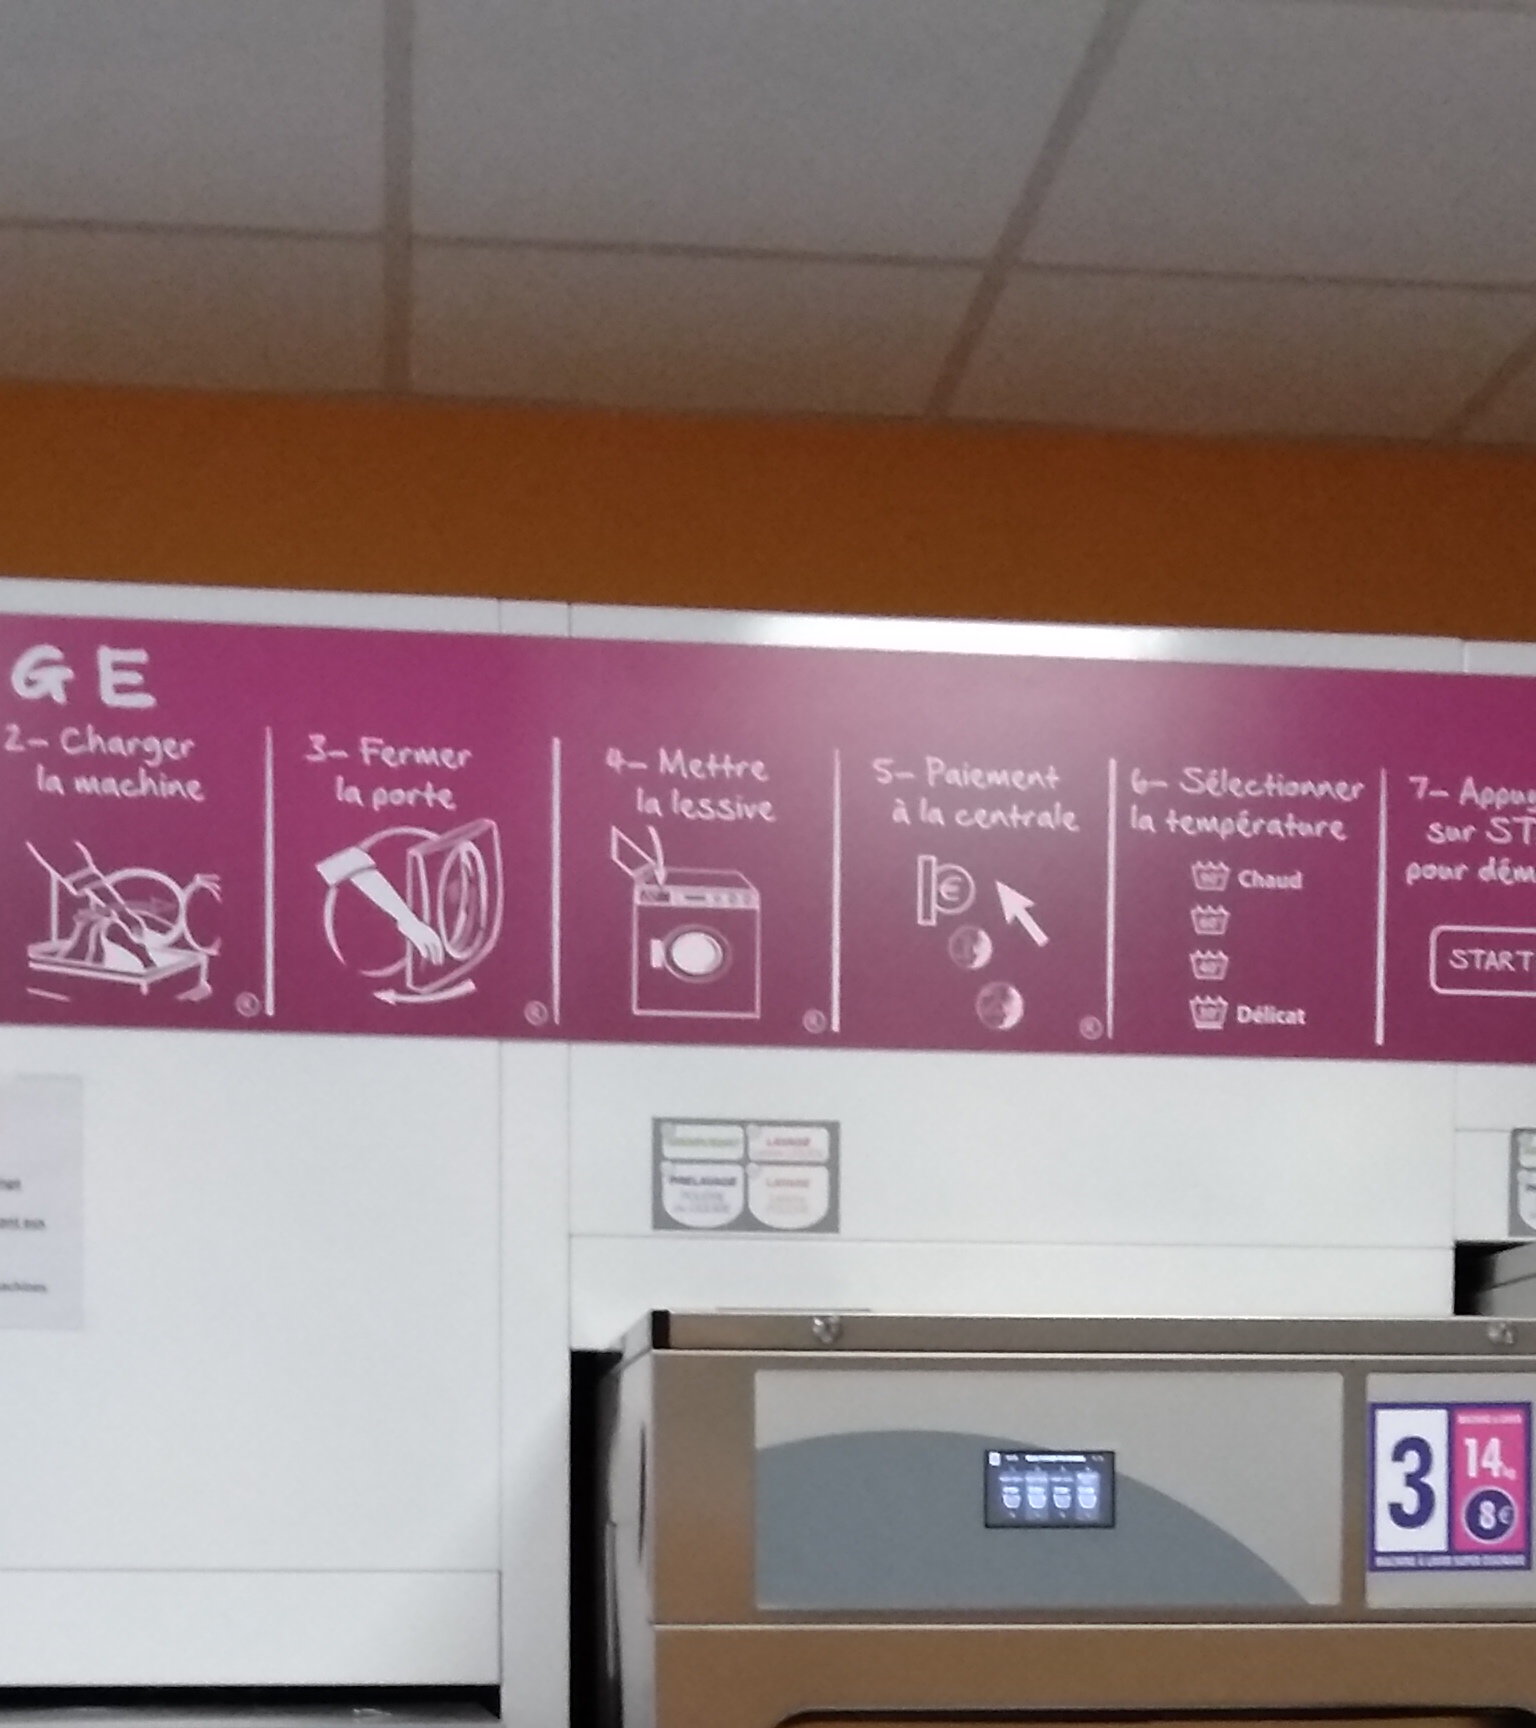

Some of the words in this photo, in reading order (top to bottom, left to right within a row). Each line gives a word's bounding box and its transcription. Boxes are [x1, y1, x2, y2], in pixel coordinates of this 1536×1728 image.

[60, 723, 195, 768] Charger
[360, 735, 473, 770] Fermer
[37, 763, 64, 796] la
[74, 766, 206, 803] machine
[659, 747, 770, 783] Mettre
[925, 755, 1061, 792] Paiement
[334, 774, 364, 807] la
[372, 780, 457, 812] porte
[1179, 766, 1365, 802] Sélectionner
[636, 786, 663, 817] la
[671, 787, 777, 823] lessive
[891, 798, 911, 826] à
[919, 796, 945, 827] la
[954, 801, 1081, 833] centrale
[1130, 804, 1157, 834] la
[1165, 808, 1348, 842] température
[1427, 821, 1477, 846] sur
[1237, 869, 1304, 890] Chaud
[1405, 861, 1469, 886] pour
[1449, 949, 1535, 972] START
[1236, 1004, 1306, 1026] Délicat
[1388, 1436, 1435, 1529] 3
